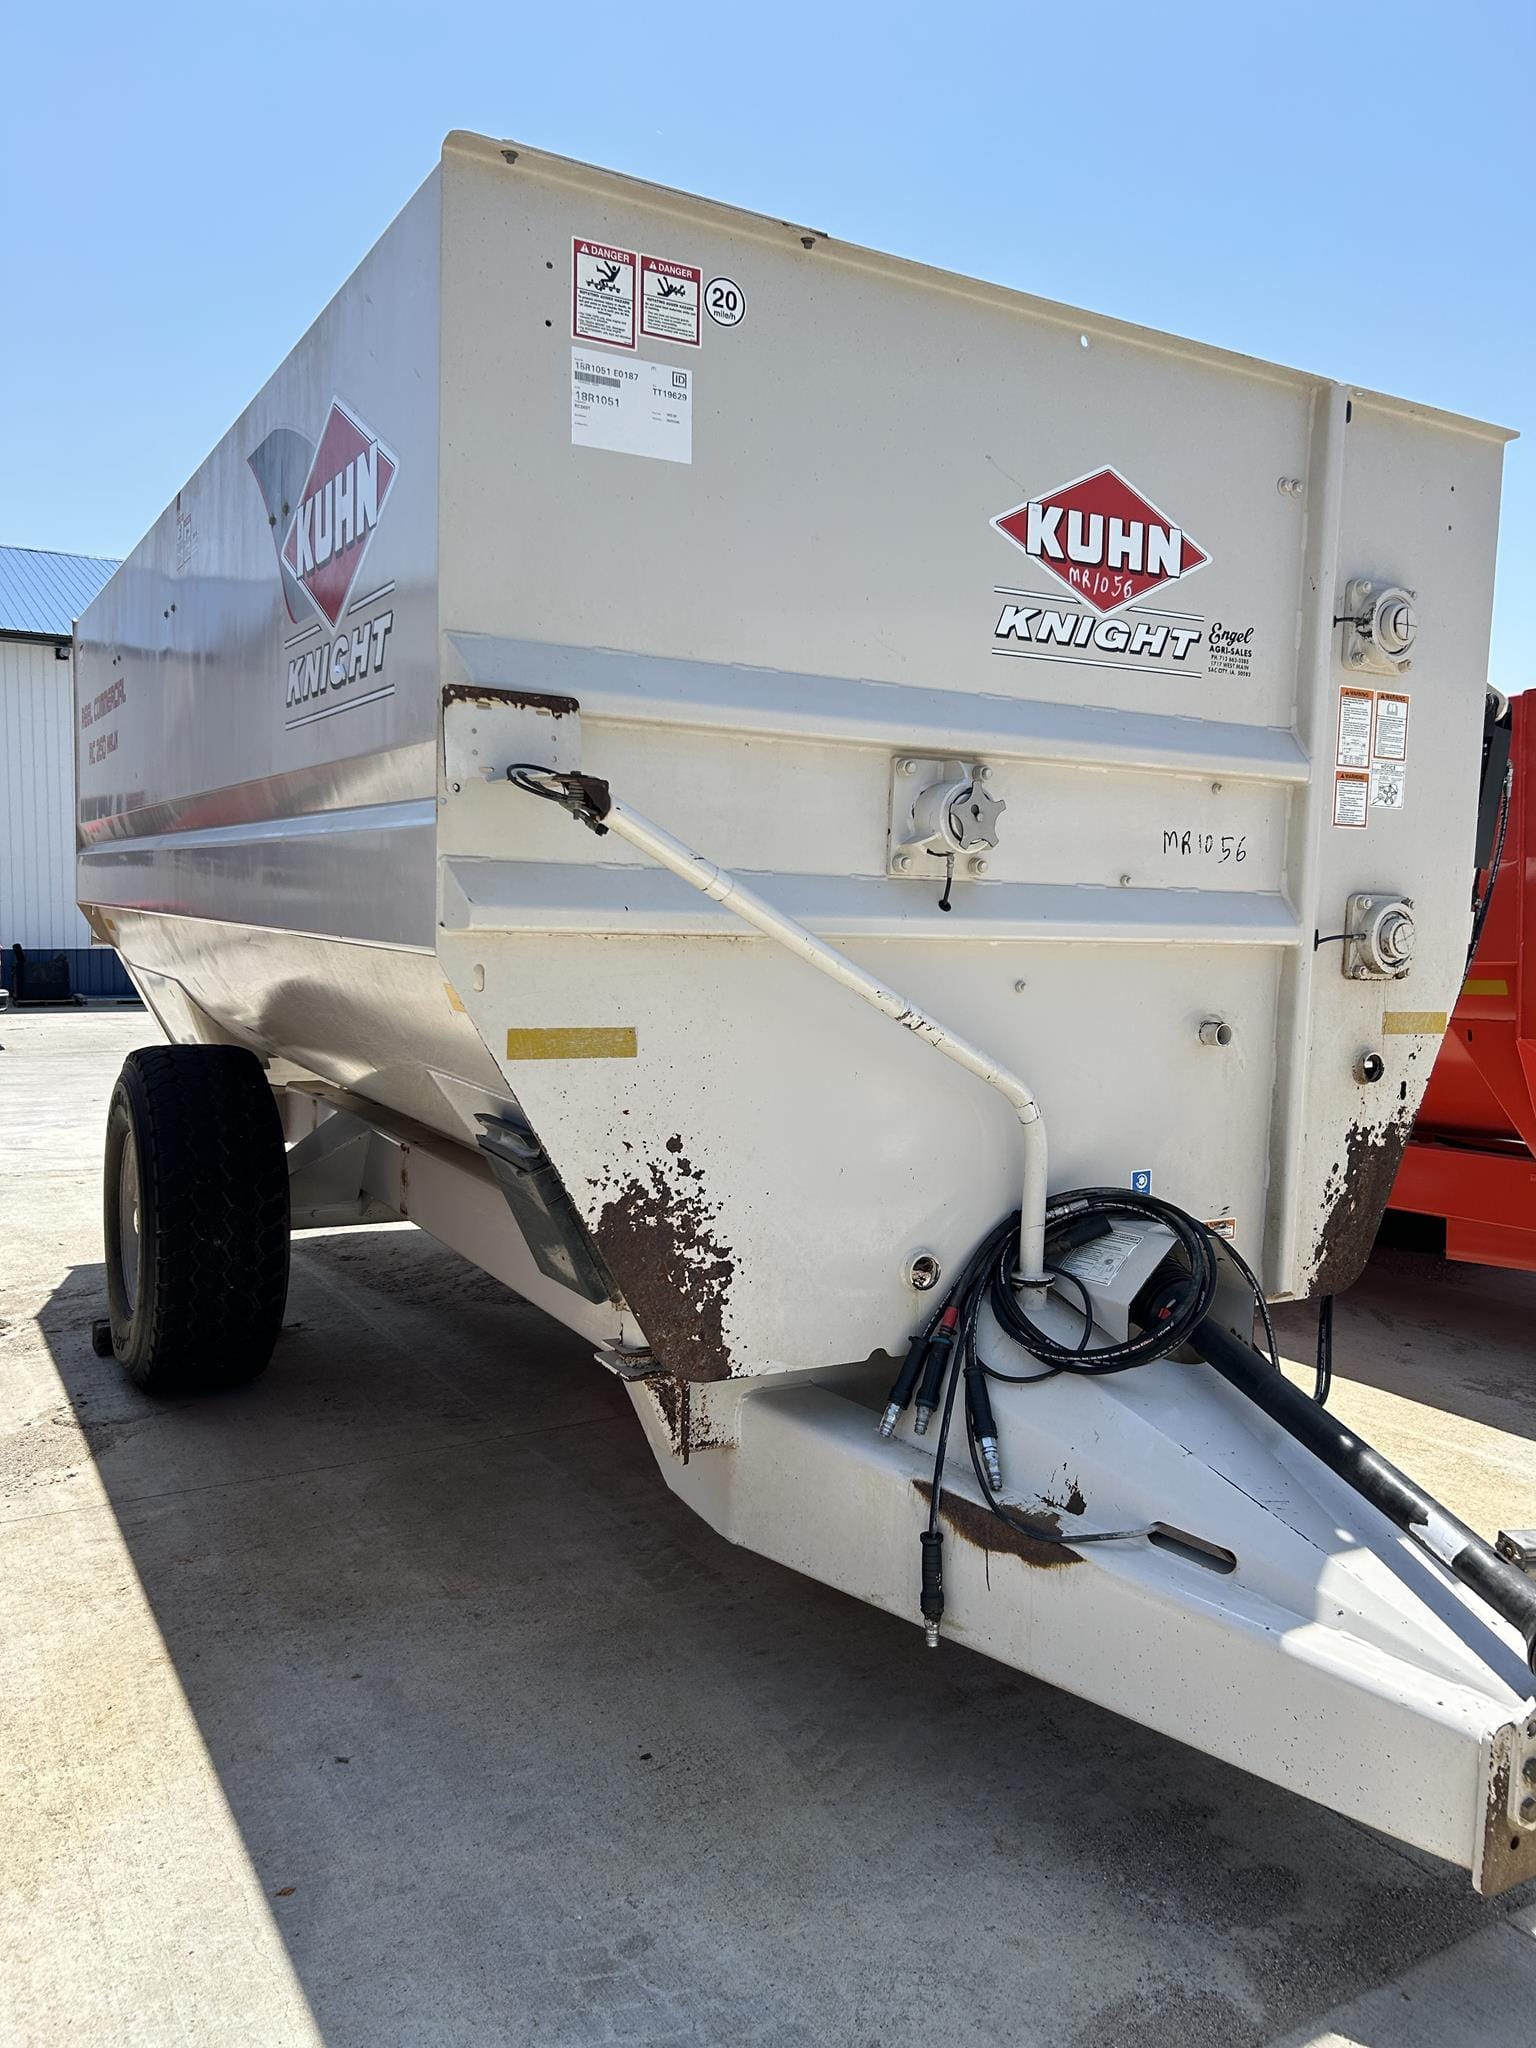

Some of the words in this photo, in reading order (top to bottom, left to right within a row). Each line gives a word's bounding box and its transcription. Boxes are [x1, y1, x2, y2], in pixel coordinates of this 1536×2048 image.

[591, 245, 630, 263] DANGER
[658, 263, 693, 279] DANGER
[712, 287, 738, 312] 20
[713, 309, 736, 321] mile/h
[613, 369, 639, 381] E0187
[675, 374, 685, 385] ID
[575, 391, 620, 408] 18R1051
[296, 439, 379, 580] KUHN
[1026, 502, 1182, 579] KUHN
[995, 605, 1202, 660] KNIGHT
[1208, 622, 1255, 646] Engel
[286, 609, 393, 707] KNIGHT
[1209, 645, 1252, 657] AGRI-SALES
[1163, 830, 1247, 864] MR1056
